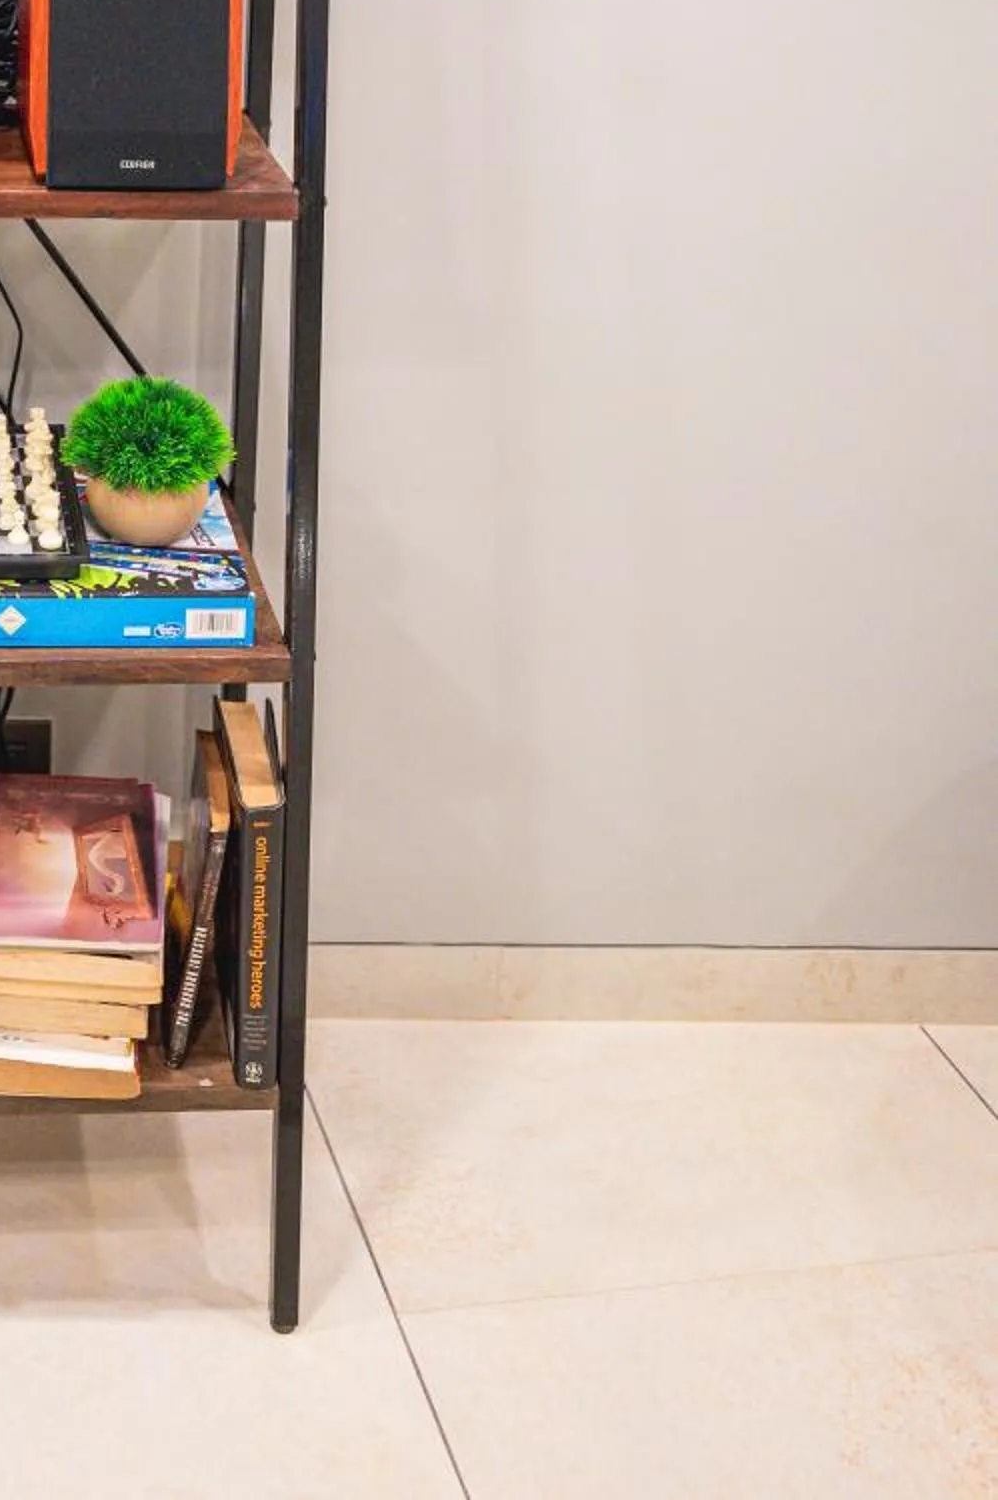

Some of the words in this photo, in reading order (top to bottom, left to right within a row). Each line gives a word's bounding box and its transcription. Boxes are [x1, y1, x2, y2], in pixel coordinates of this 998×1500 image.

[254, 835, 271, 882] online
[247, 885, 269, 957] marketing
[249, 961, 267, 1009] heroes
